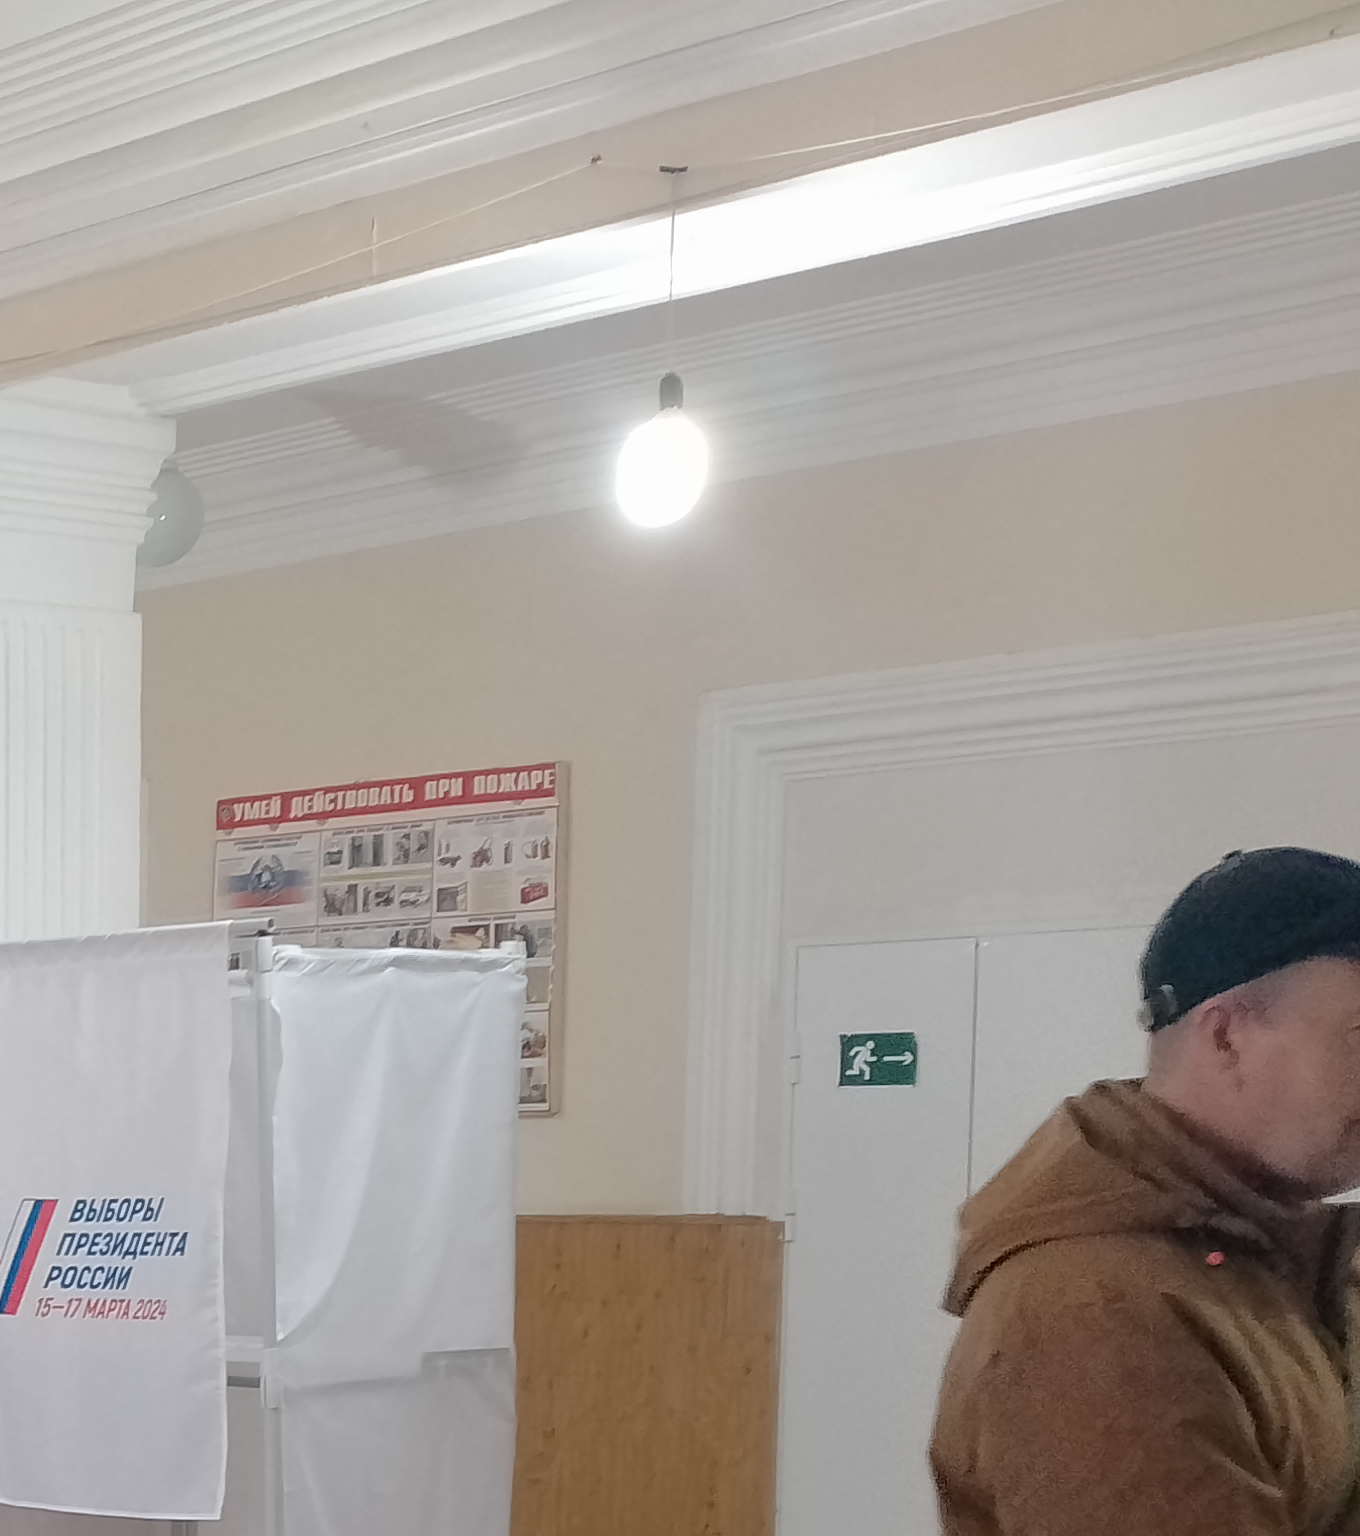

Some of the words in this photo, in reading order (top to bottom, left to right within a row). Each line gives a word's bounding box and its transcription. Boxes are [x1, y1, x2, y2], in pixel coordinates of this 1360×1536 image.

[233, 796, 281, 822] УМЕЙ
[288, 783, 415, 818] ДЕЙСТВОВАТЬ
[423, 775, 464, 800] ПРИ
[472, 769, 555, 797] ПОЖАРЕ
[68, 1196, 165, 1223] ВЫБОРЫ
[56, 1231, 188, 1260] ПРЕЗИДЕНТА
[43, 1265, 133, 1290] РОССИИ
[82, 1298, 130, 1320] МАРТА
[132, 1299, 168, 1321] 2024
